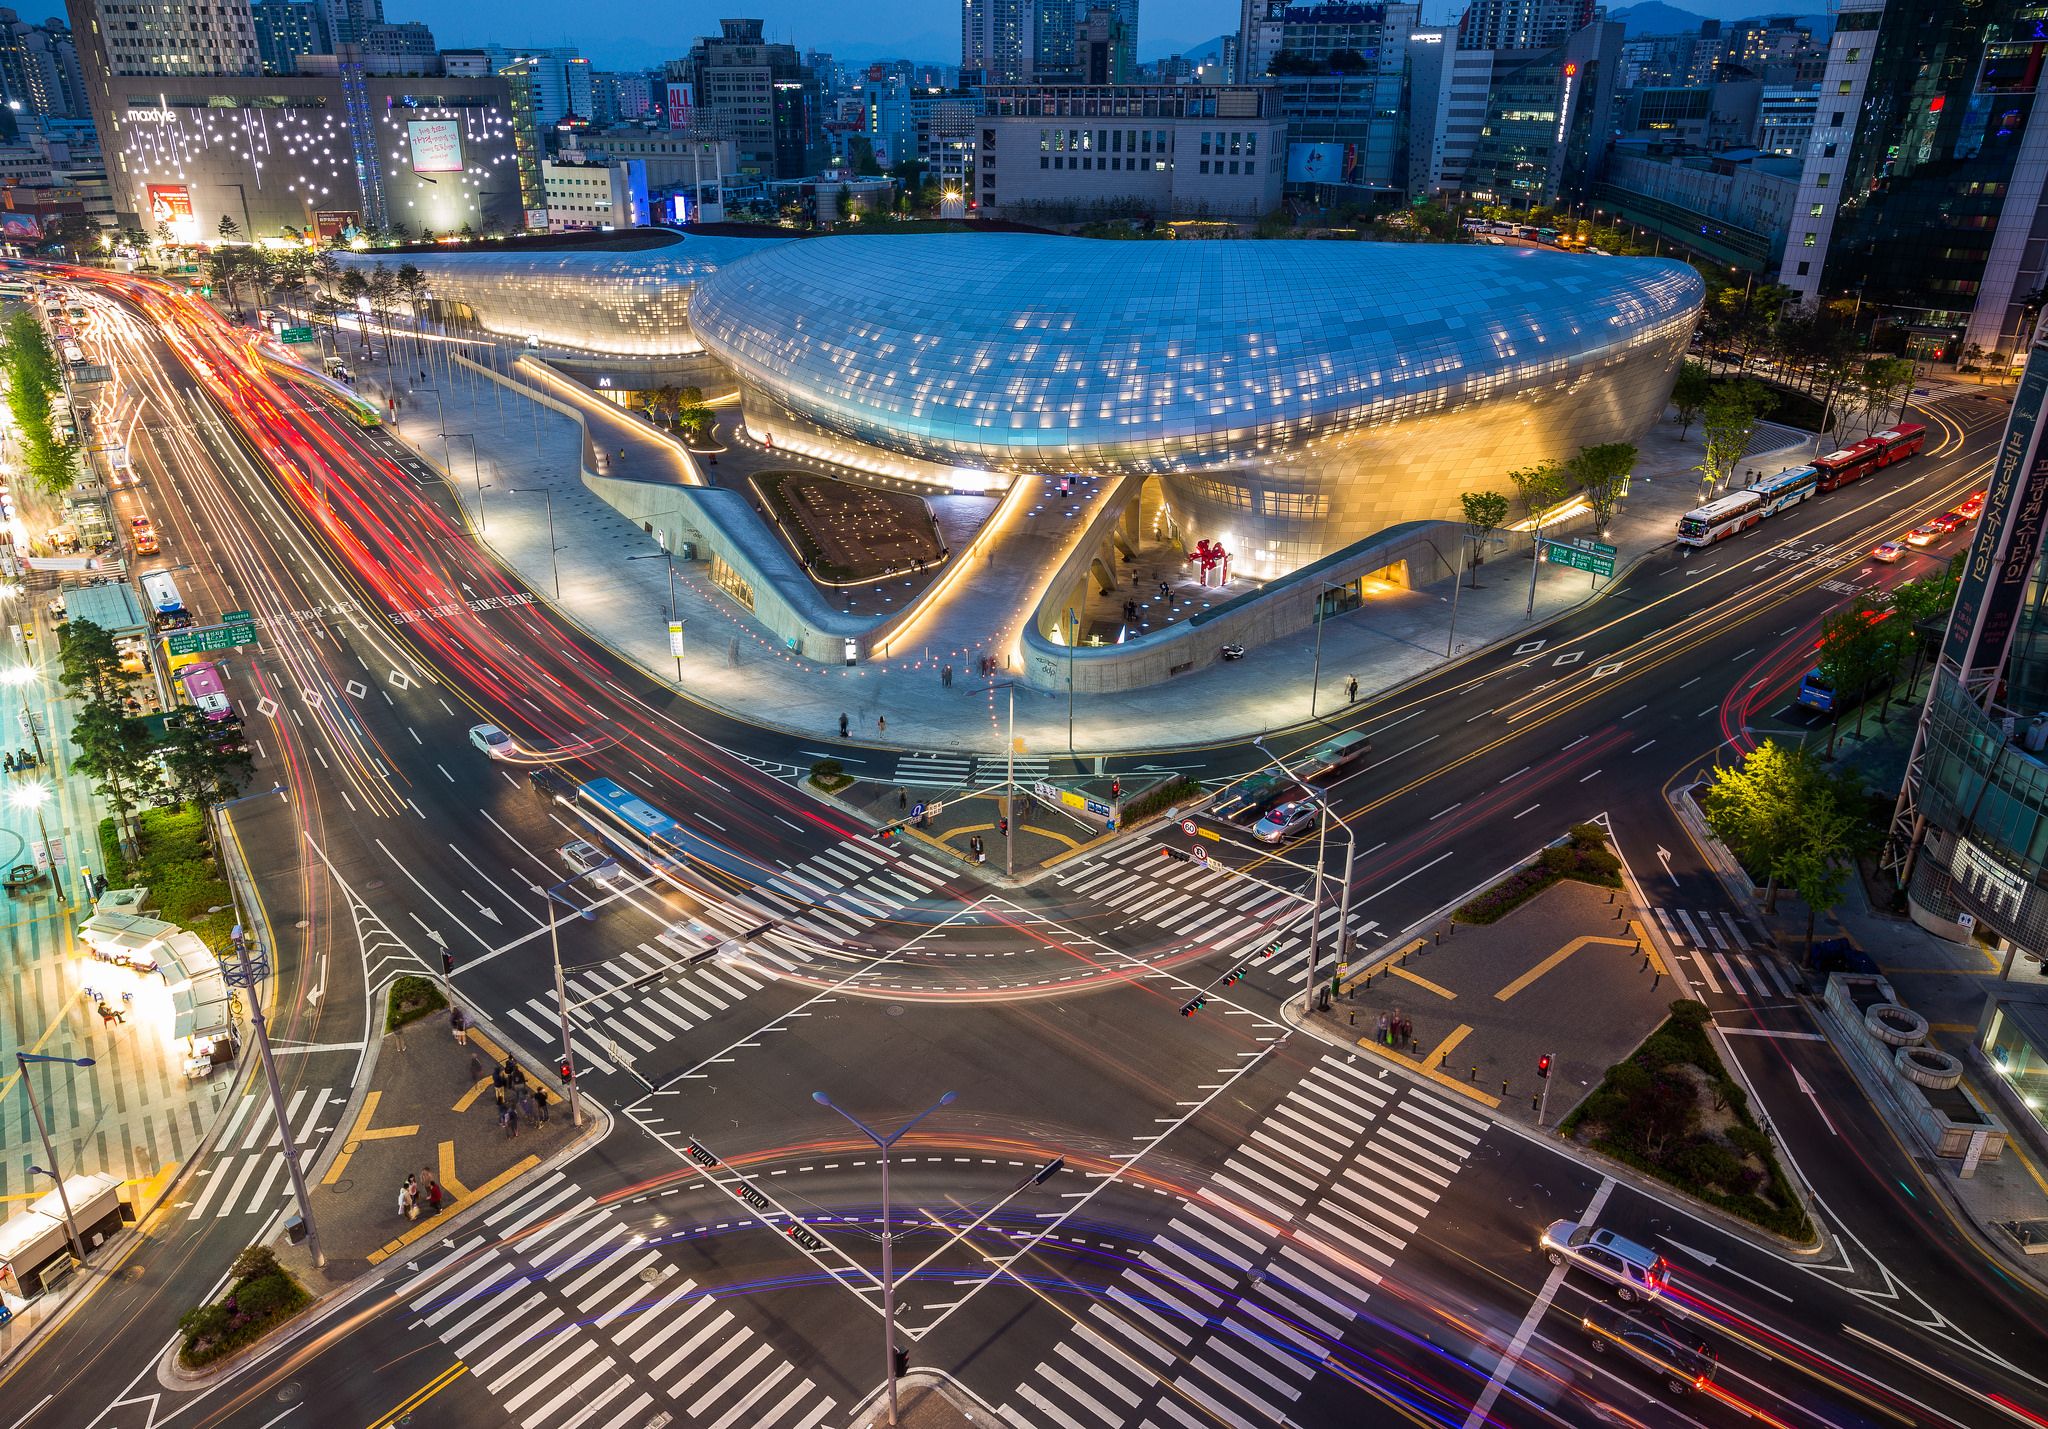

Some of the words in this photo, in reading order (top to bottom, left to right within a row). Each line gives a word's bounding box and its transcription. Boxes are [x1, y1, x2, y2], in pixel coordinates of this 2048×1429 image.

[127, 93, 177, 127] maxtyle
[670, 89, 692, 107] ALL
[1972, 431, 2025, 582] 프랑켄슈타인
[466, 597, 503, 612] 동대문
